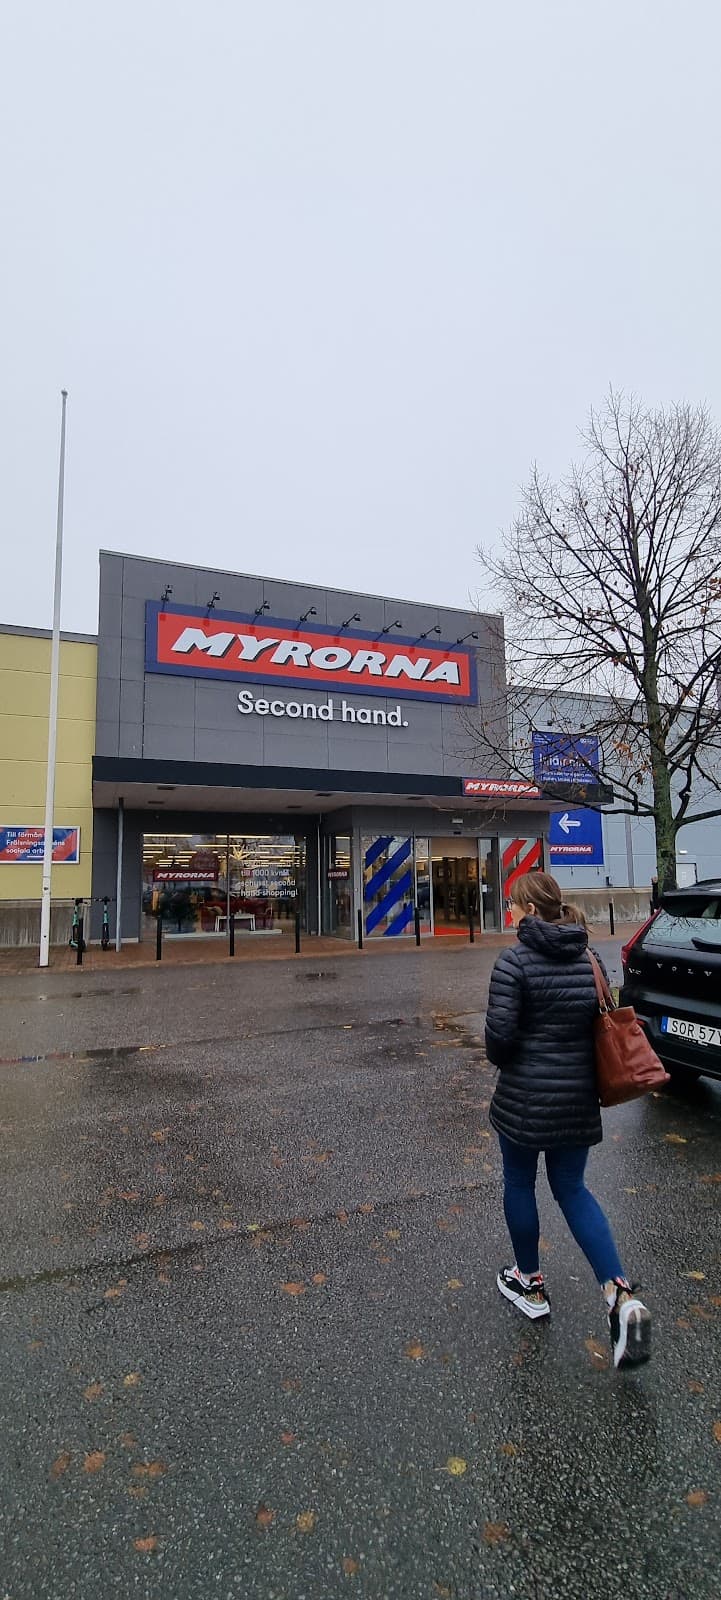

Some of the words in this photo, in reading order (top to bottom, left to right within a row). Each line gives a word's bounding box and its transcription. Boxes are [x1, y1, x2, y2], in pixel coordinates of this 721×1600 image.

[171, 627, 460, 685] MYRORNA
[237, 690, 333, 721] Second
[342, 700, 409, 727] hand.
[466, 782, 539, 793] MYRORNA
[671, 1020, 695, 1038] SOR
